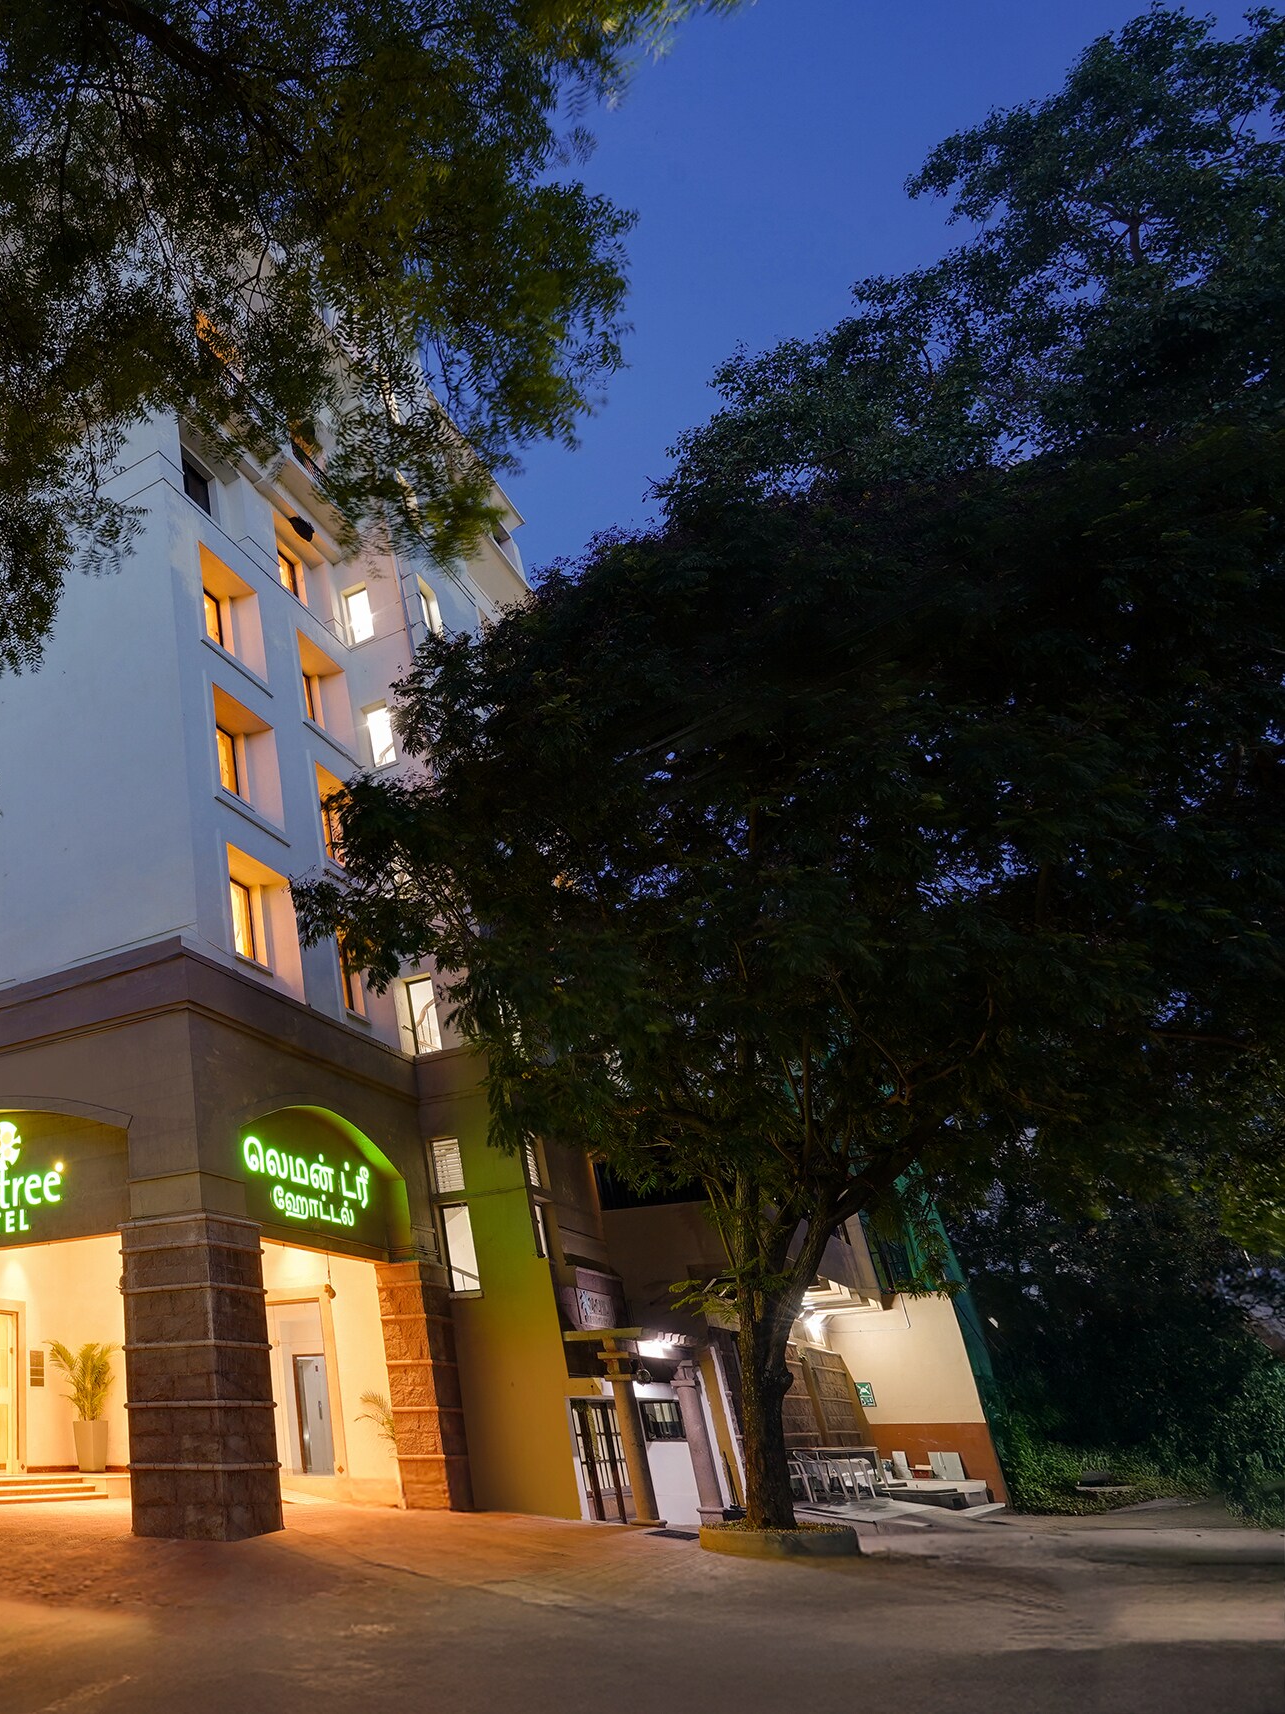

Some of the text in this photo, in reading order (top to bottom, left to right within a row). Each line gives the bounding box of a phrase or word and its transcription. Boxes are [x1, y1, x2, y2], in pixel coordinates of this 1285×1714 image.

[243, 1136, 370, 1209] லெமன் ட்ரீ
[272, 1184, 355, 1227] ஹோட்டல்
